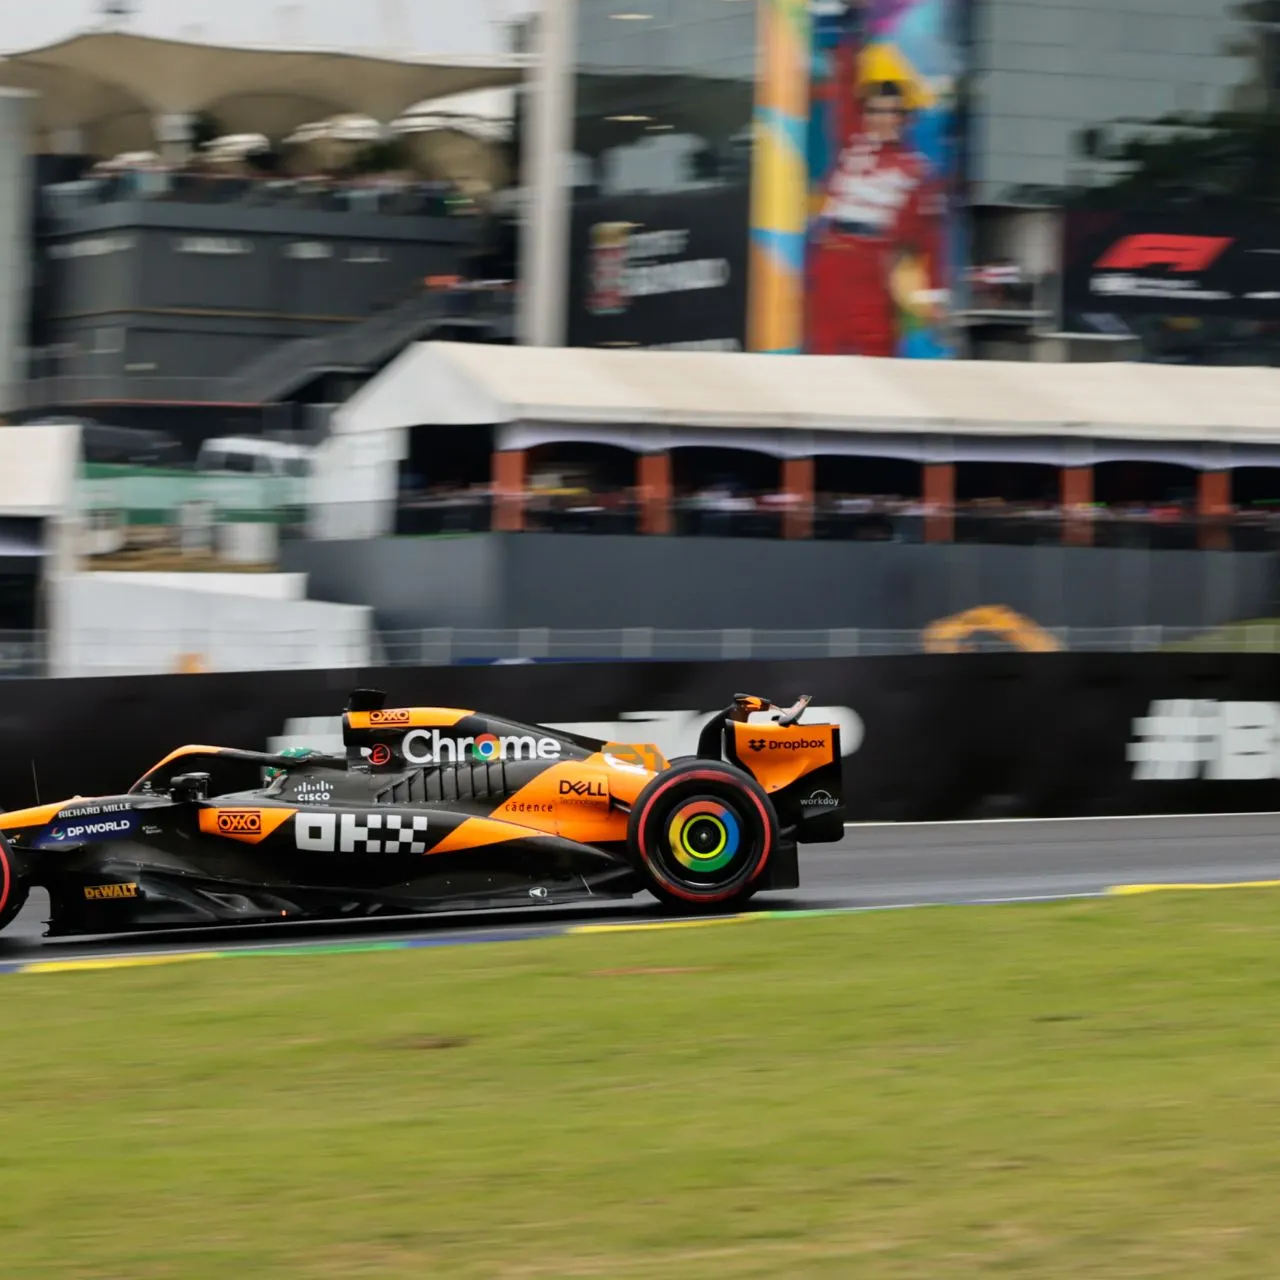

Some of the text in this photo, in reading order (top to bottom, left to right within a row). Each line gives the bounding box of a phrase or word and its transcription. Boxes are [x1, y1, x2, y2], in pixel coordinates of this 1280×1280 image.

[370, 711, 410, 721] OXXO
[401, 729, 562, 764] Chrome
[768, 738, 825, 751] Dropbox
[559, 780, 607, 796] DELL
[58, 802, 132, 819] RICHARD MILLE
[800, 798, 839, 806] workday
[67, 826, 84, 837] DP
[85, 820, 130, 834] WORLD
[219, 815, 261, 832] OXXO
[295, 813, 428, 854] OKX
